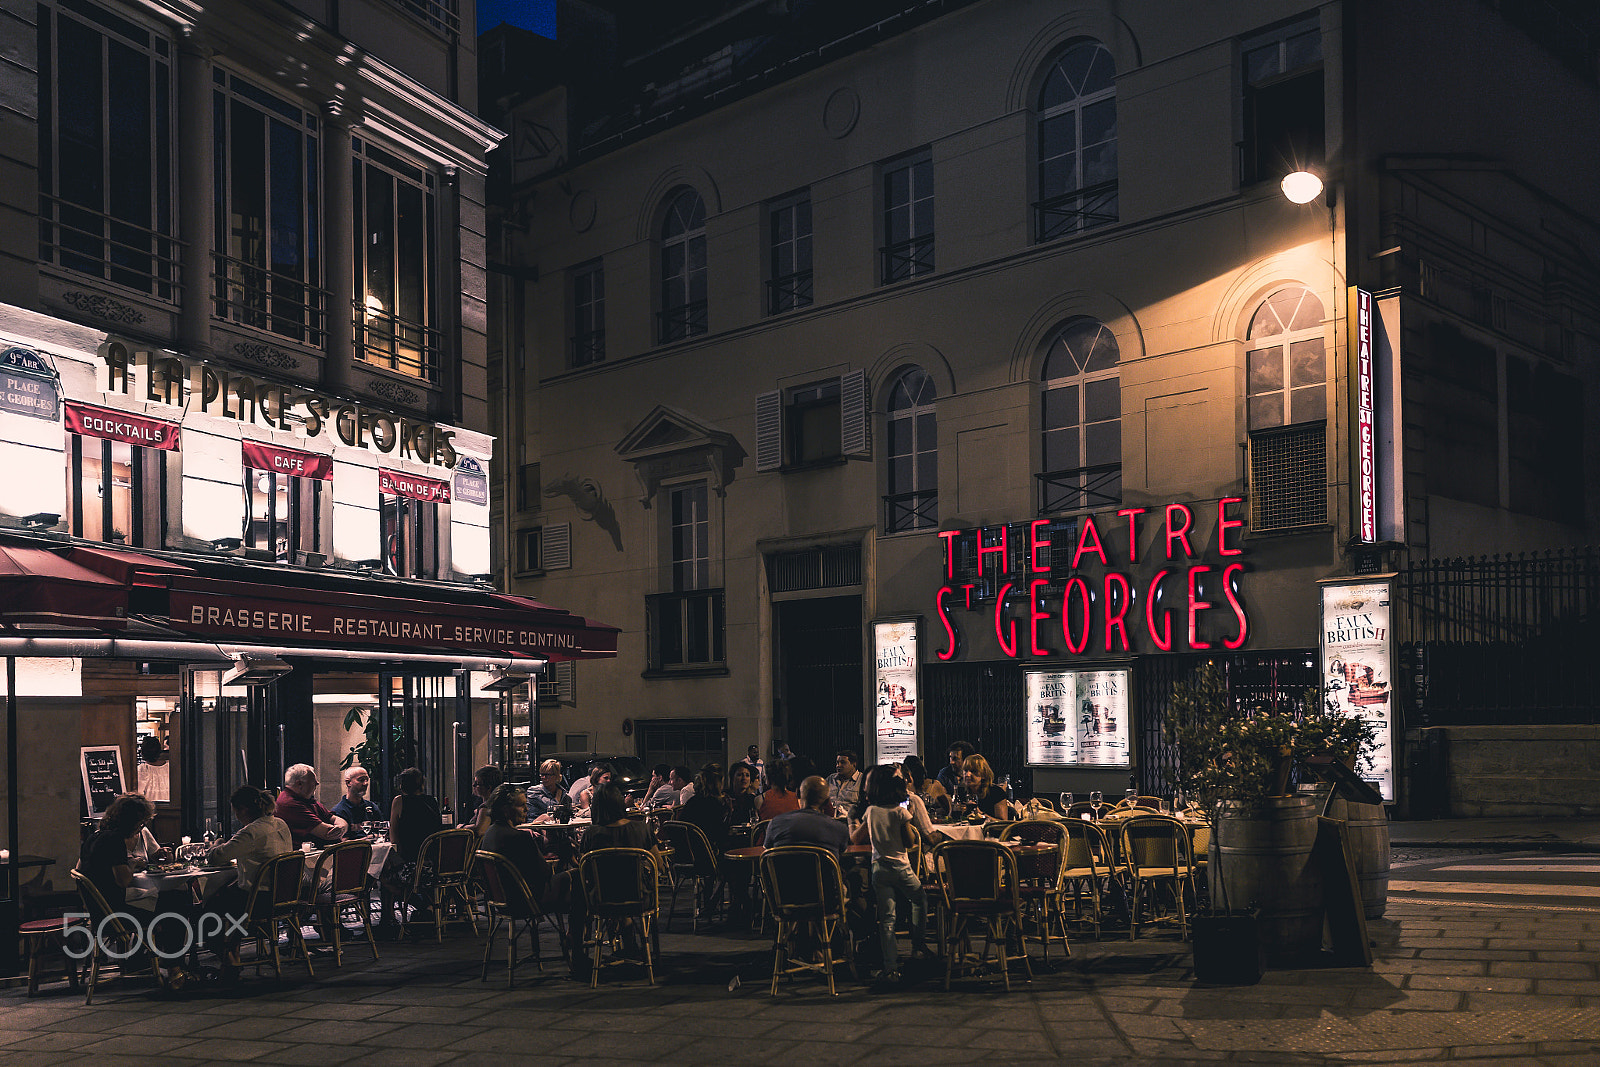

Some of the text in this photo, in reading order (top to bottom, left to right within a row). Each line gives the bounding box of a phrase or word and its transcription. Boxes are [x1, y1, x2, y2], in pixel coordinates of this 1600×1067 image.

[1358, 292, 1371, 409] THEATRE
[7, 378, 41, 395] PLACE
[7, 393, 53, 411] GEORGES
[143, 351, 184, 407] LA
[198, 364, 292, 431] PLACE
[335, 404, 456, 469] GEORGES
[83, 416, 163, 442] COCKTAILS
[274, 455, 304, 471] CAFE
[382, 478, 449, 499] SALON DE THE
[462, 477, 480, 488] PLACE
[1360, 425, 1373, 541] GEORGES
[937, 497, 1244, 580] THEATRE
[995, 562, 1250, 657] GEORGES
[191, 605, 576, 648] BRASSERIE RESTAURANT SERVICE CONTINU
[1336, 613, 1374, 629] FAUX
[1327, 627, 1386, 643] BRITISH
[883, 645, 906, 657] FAUX
[877, 656, 914, 669] BRITISH
[1045, 682, 1066, 691] FAUX
